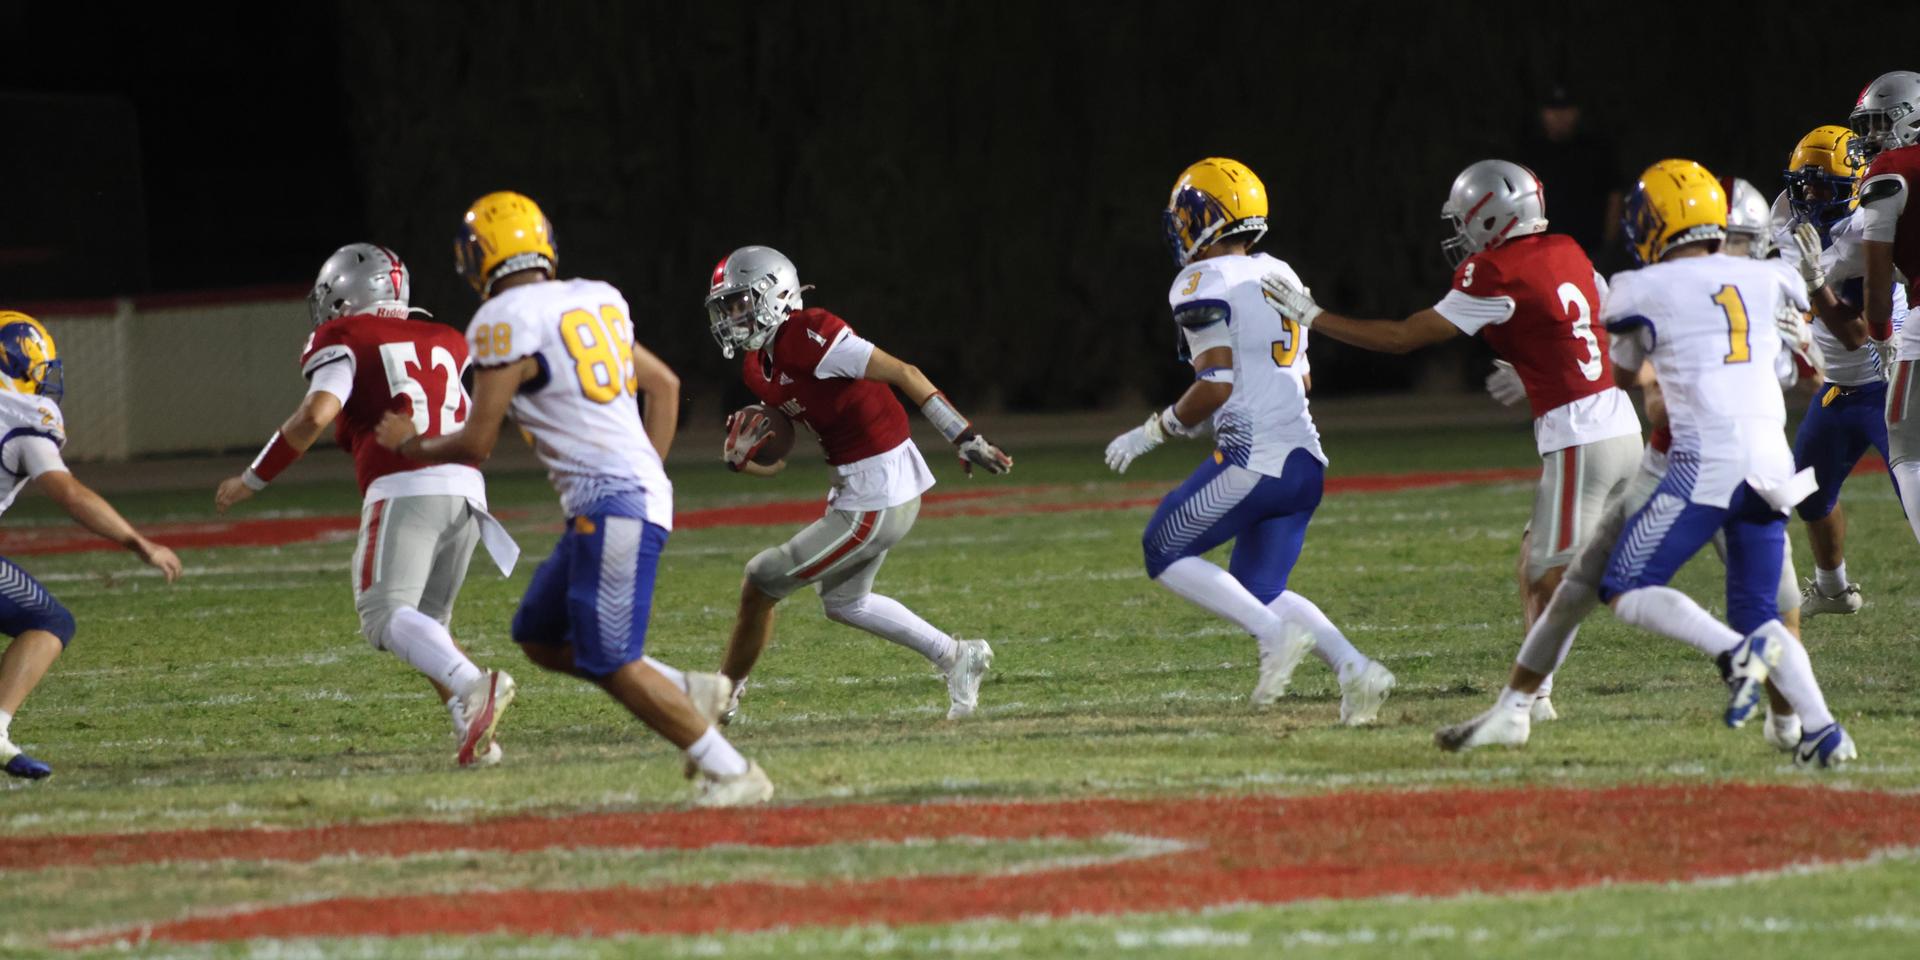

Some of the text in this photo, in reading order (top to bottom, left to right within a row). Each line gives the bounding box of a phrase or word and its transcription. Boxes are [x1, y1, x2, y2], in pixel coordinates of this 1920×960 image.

[1181, 271, 1203, 296] 3
[1462, 262, 1476, 288] 3
[475, 321, 512, 358] 88
[806, 328, 828, 348] 1
[1557, 282, 1603, 382] 3
[1711, 284, 1751, 364] 1
[558, 303, 638, 404] 88
[378, 341, 468, 436] 52
